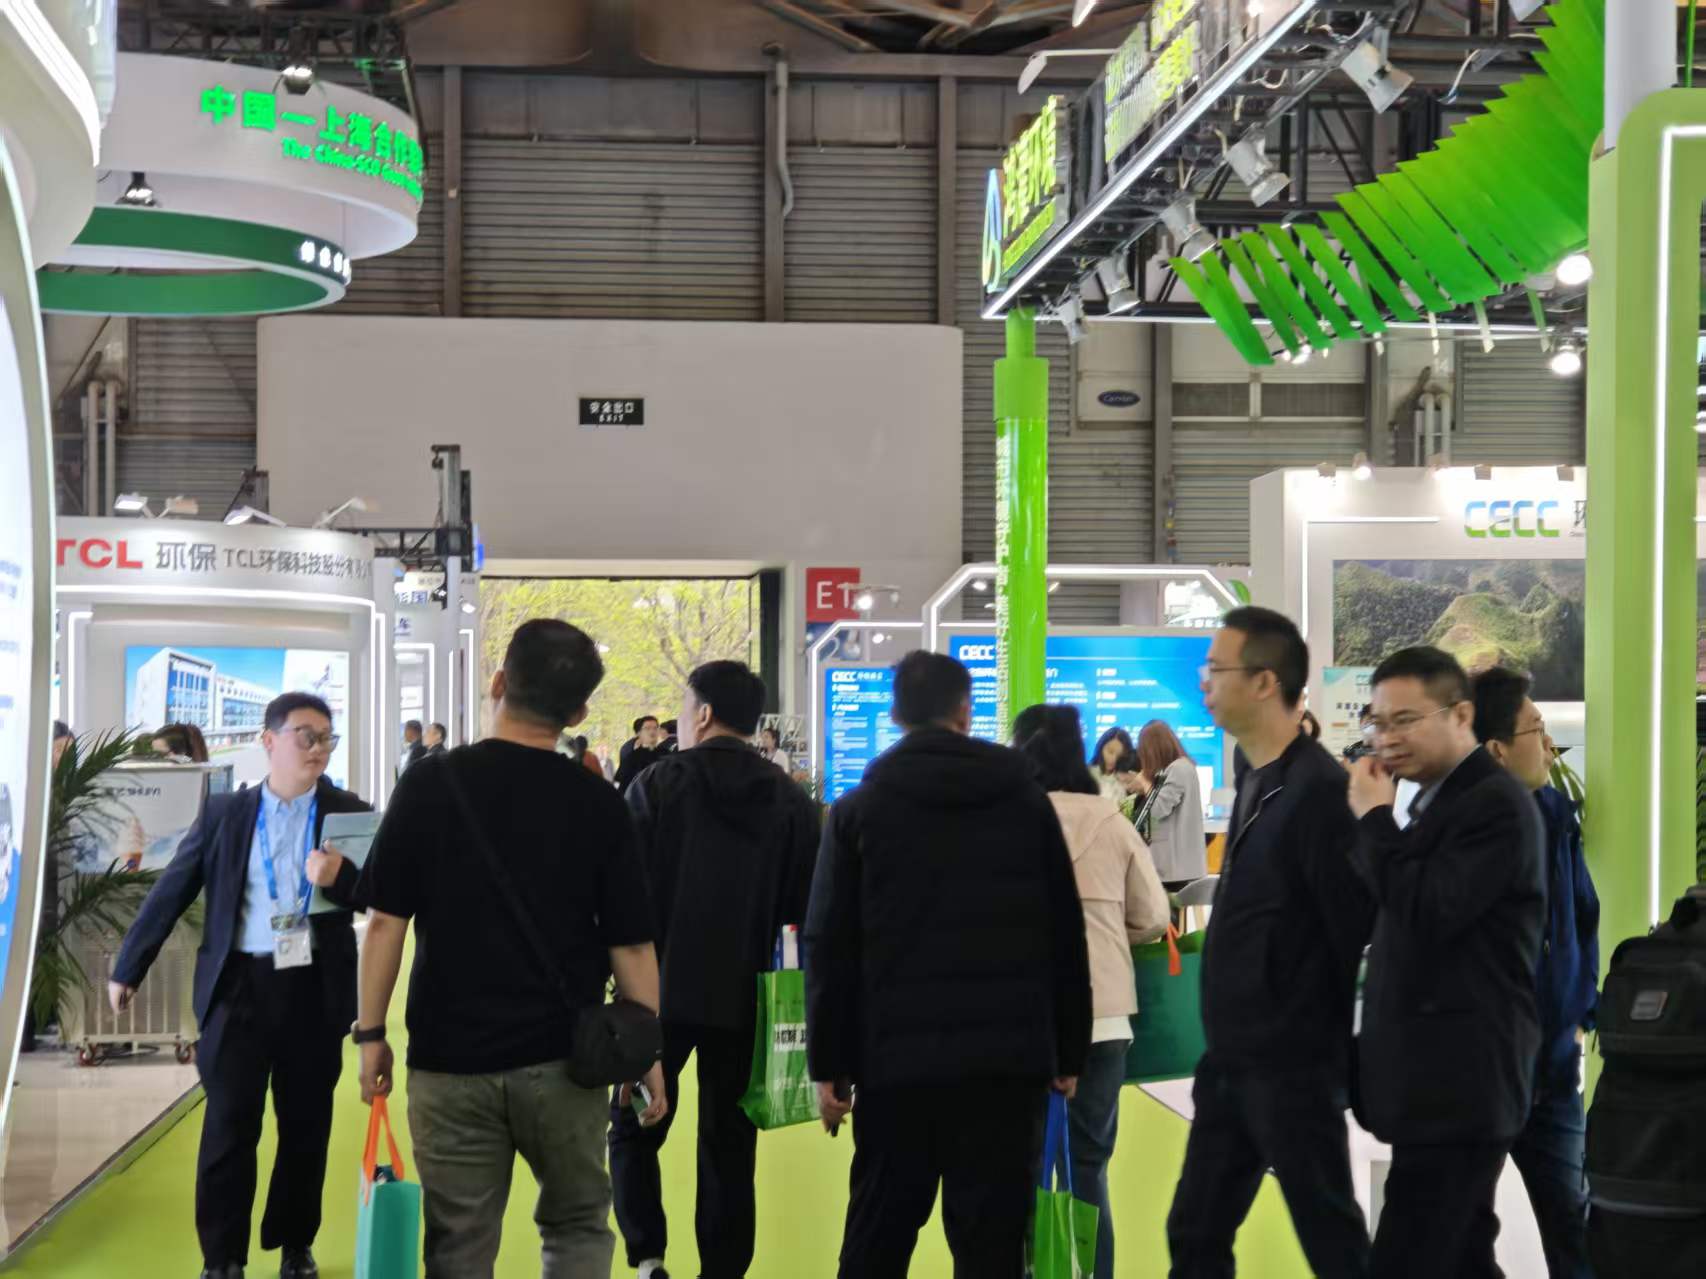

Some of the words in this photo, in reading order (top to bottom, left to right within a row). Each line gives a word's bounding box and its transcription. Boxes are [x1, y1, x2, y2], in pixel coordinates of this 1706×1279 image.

[1464, 500, 1560, 538] CECC
[56, 538, 144, 569] TCL
[156, 541, 217, 572] 环保
